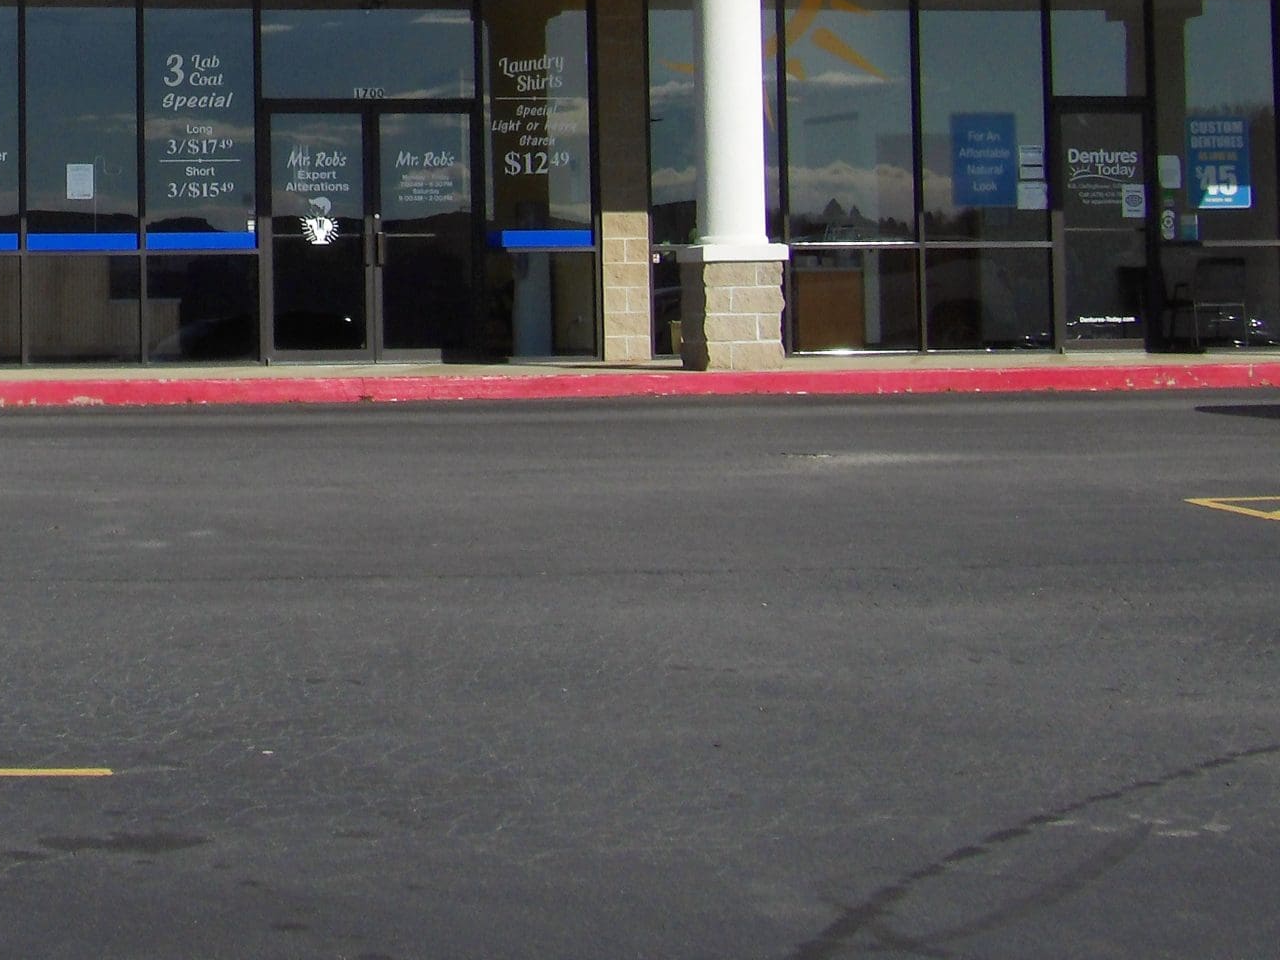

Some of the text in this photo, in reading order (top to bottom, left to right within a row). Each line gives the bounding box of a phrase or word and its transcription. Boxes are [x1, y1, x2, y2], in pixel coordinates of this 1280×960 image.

[191, 54, 220, 71] Lab
[498, 54, 564, 78] Laundry
[163, 54, 185, 87] 3
[189, 72, 224, 86] Coat
[517, 75, 562, 92] Shirts
[356, 87, 384, 99] 1700
[162, 92, 233, 111] Special
[516, 104, 558, 118] Special
[186, 124, 213, 135] Long
[492, 120, 521, 134] Light
[526, 122, 539, 131] or
[1190, 121, 1243, 134] CUSTOM
[519, 135, 556, 146] Starch
[967, 130, 1000, 141] For An
[1190, 135, 1244, 149] DENTURES
[287, 151, 347, 169] Mr. Rob's
[395, 150, 454, 168] Mr. Rob's
[1067, 148, 1138, 164] Dentures
[185, 166, 215, 176] Short
[297, 170, 336, 181] Expert
[967, 163, 1004, 176] Natural
[1095, 163, 1136, 178] Today
[286, 182, 349, 192] Alterations
[973, 182, 998, 192] Look
